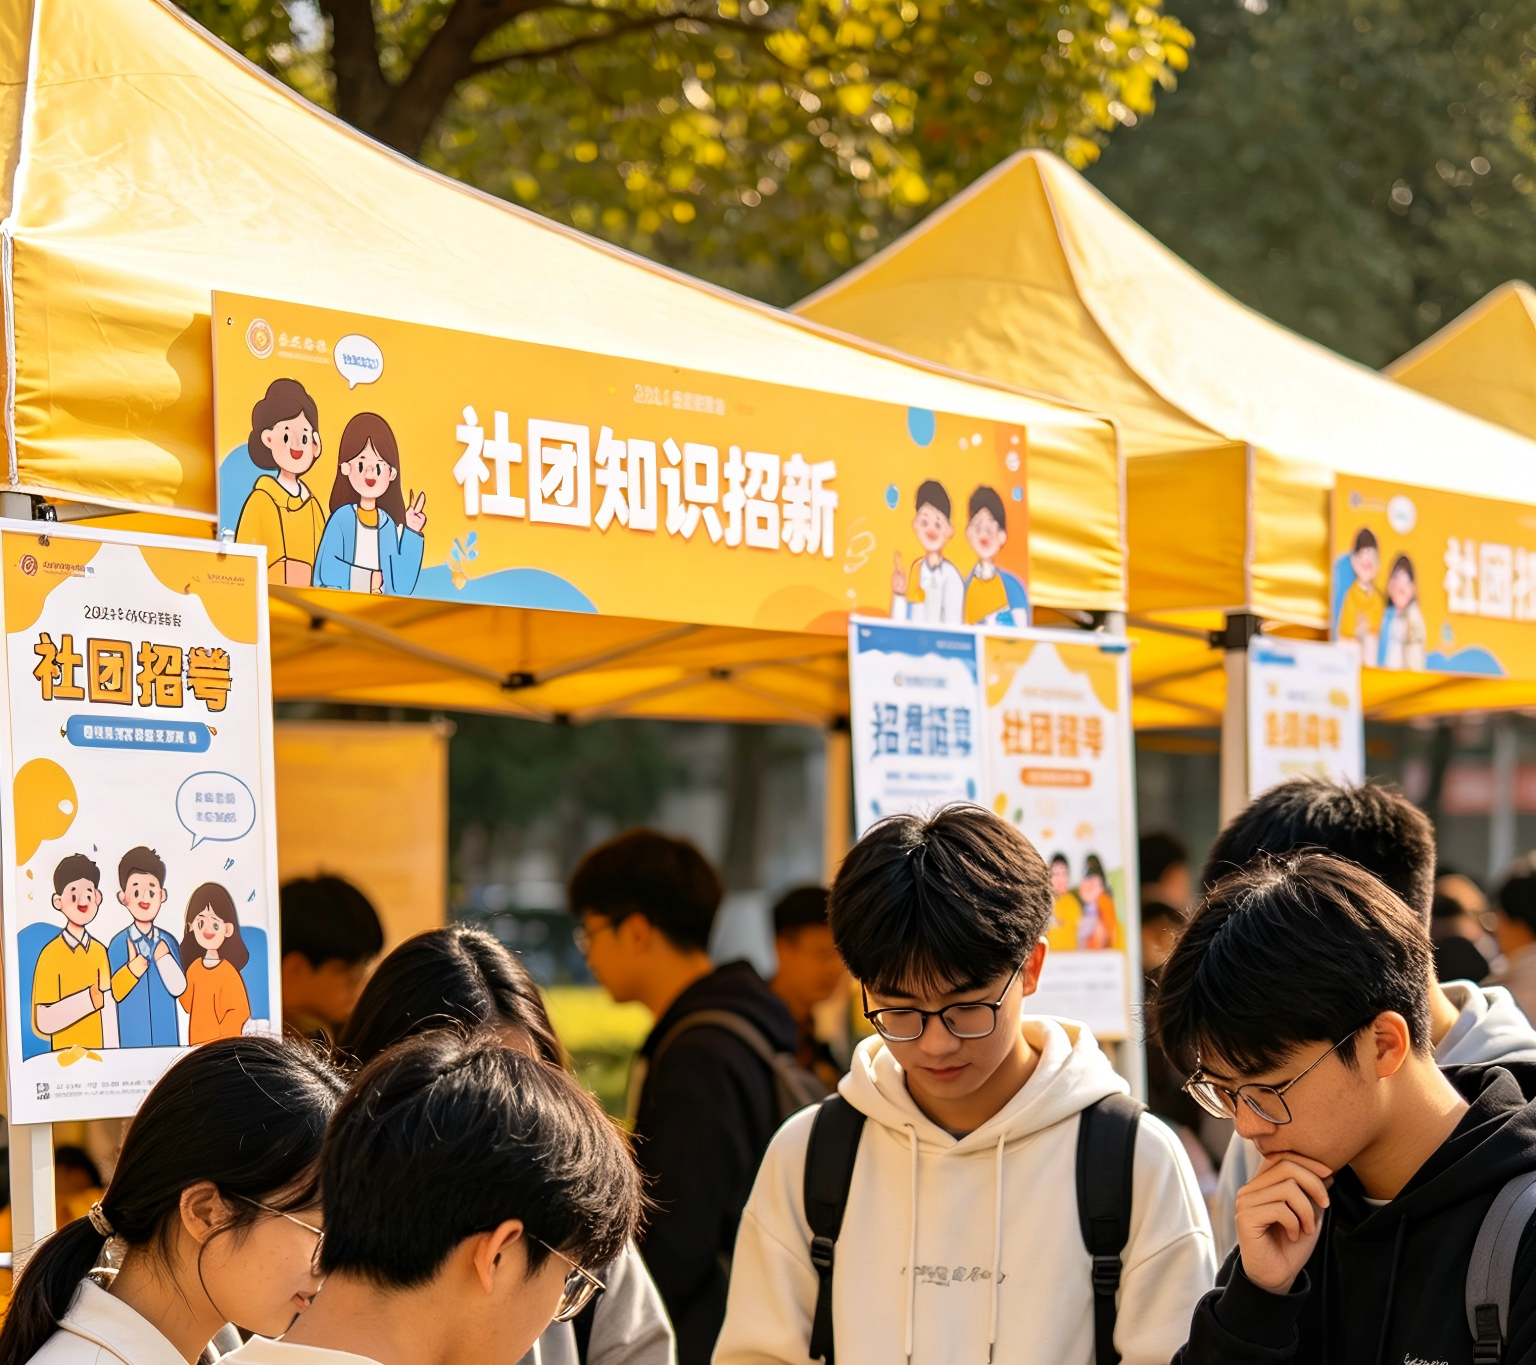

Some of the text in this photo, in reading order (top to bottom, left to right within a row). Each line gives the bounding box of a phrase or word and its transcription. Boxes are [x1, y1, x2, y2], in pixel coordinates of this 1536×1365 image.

[453, 405, 840, 559] 社团知识招新
